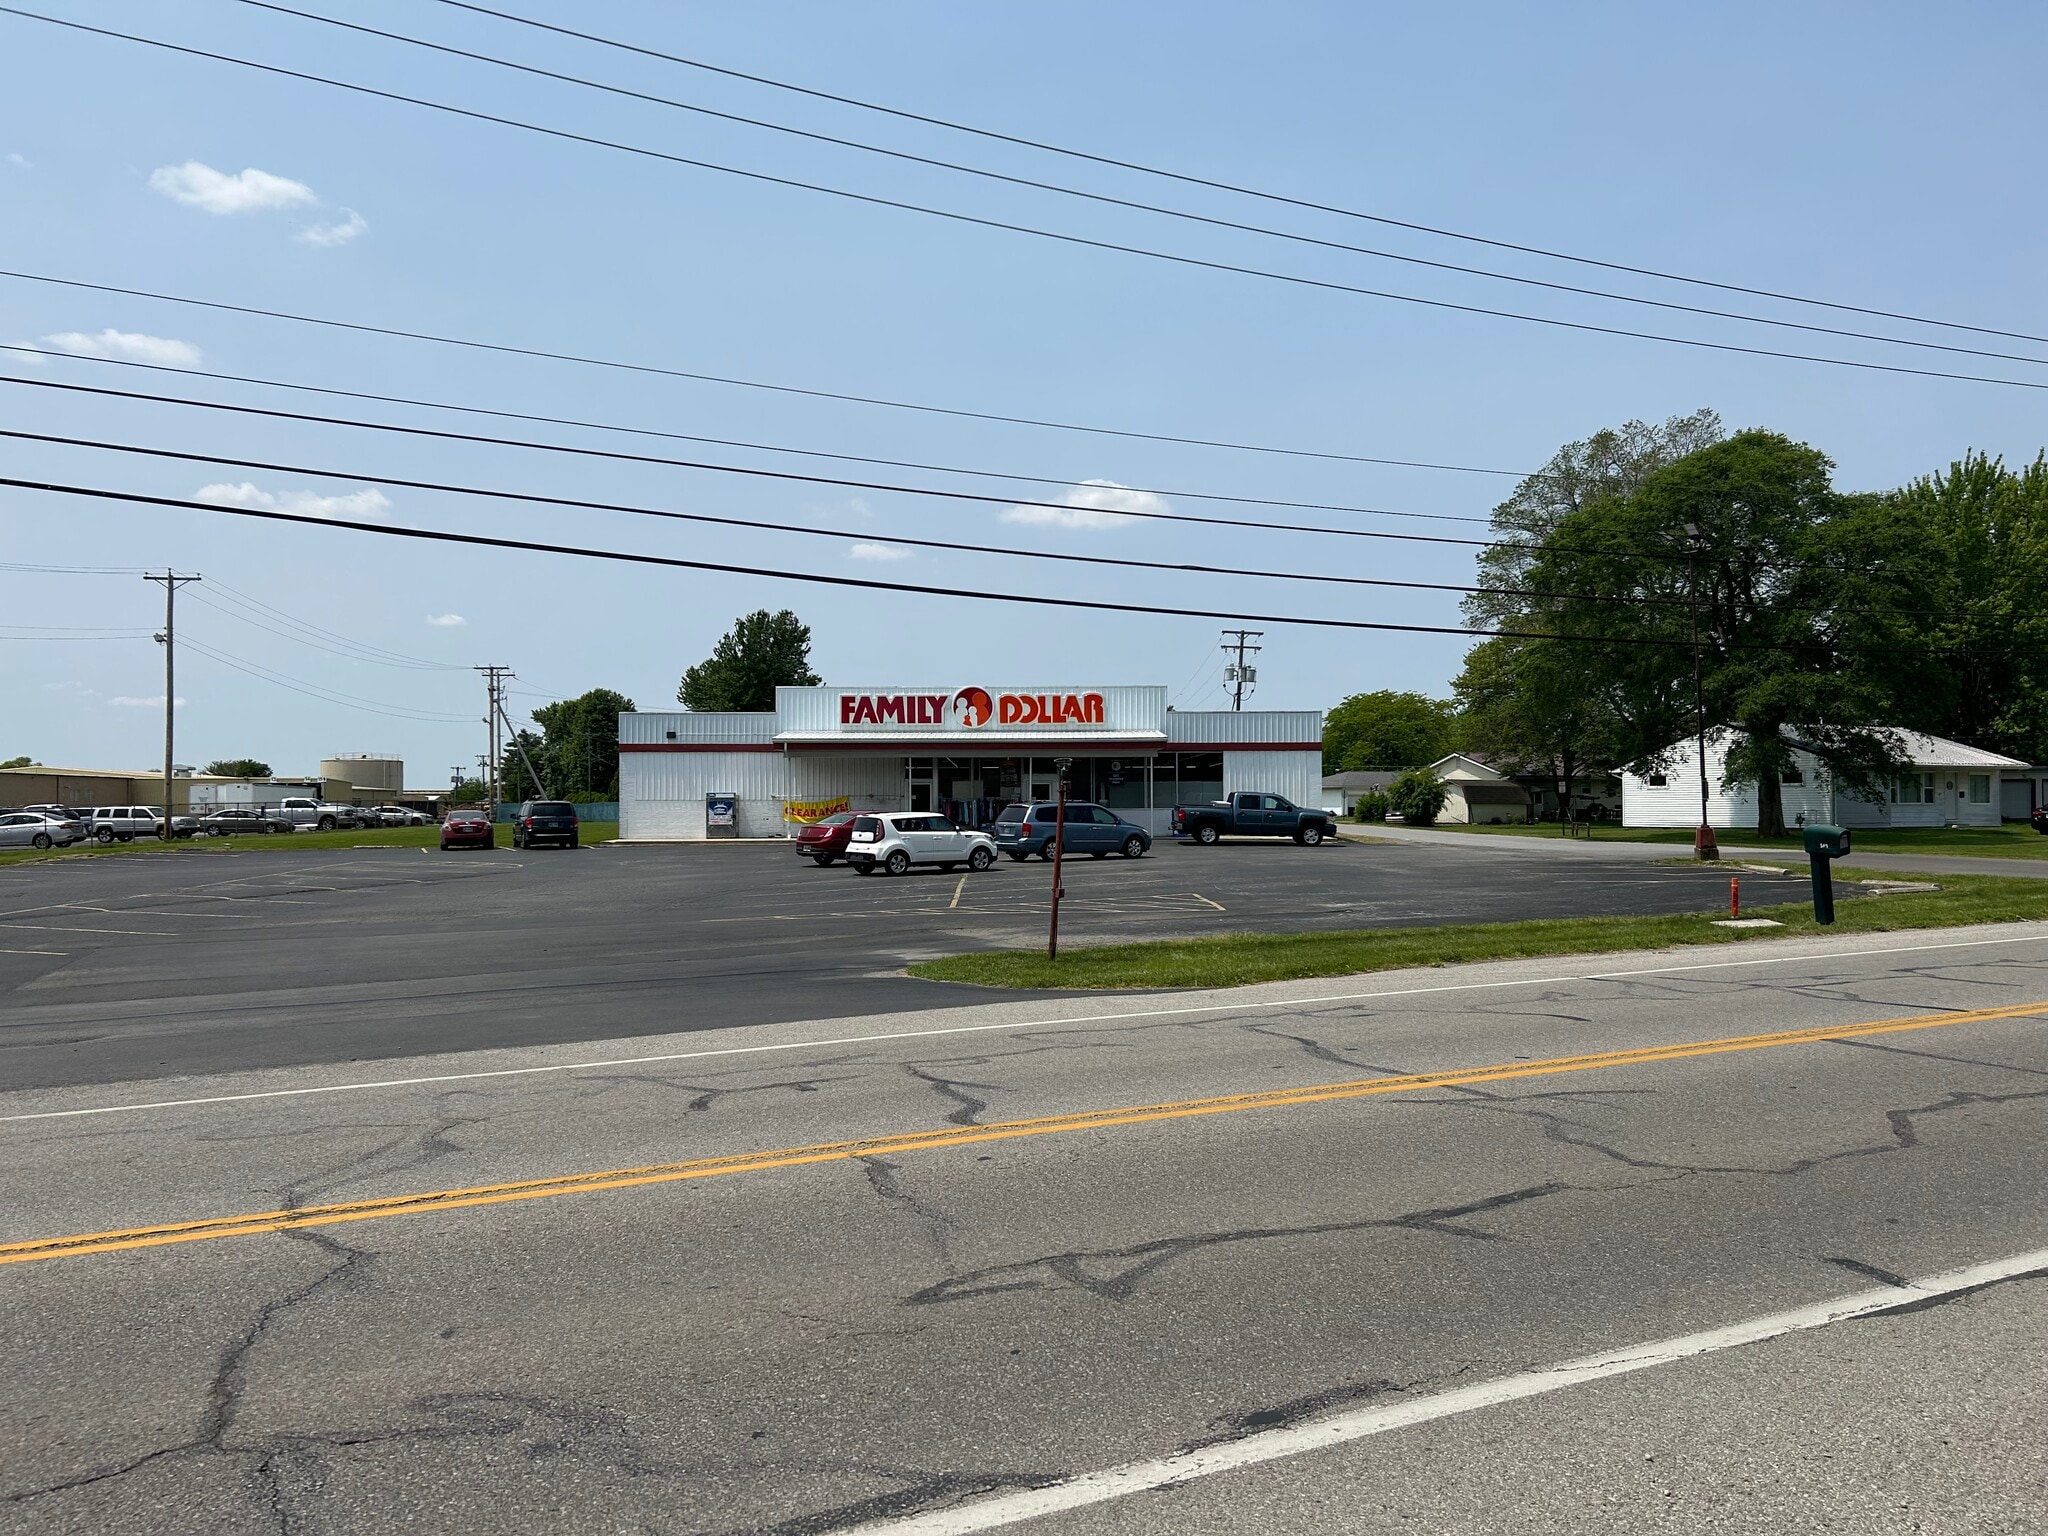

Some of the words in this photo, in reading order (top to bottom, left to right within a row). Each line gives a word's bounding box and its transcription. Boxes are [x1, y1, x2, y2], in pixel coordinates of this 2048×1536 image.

[841, 695, 948, 724] FAMILY
[999, 694, 1105, 724] DOLLAR
[785, 802, 848, 817] CLEARANCE!
